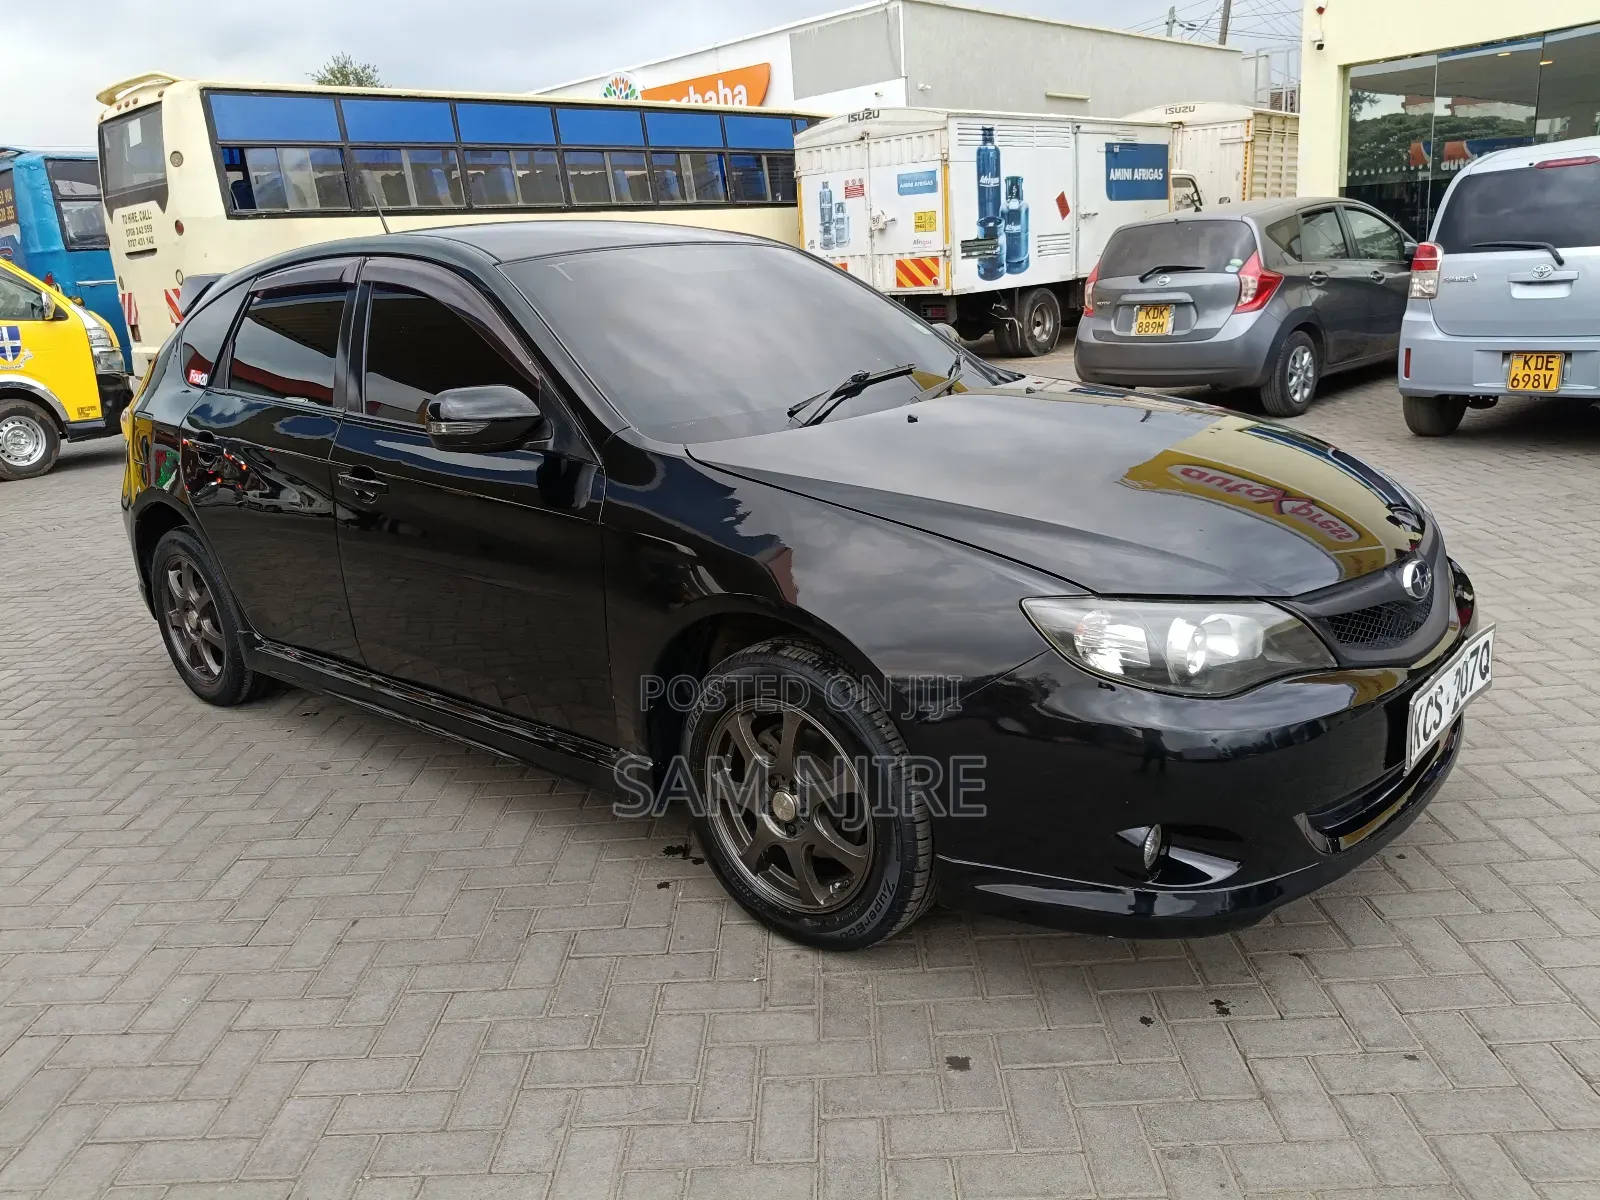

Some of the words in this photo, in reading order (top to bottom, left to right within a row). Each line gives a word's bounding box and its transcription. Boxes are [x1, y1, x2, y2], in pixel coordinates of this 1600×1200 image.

[848, 109, 880, 123] ISUZU
[1165, 105, 1196, 115] ISUZU
[1109, 168, 1132, 181] AMINI
[1133, 168, 1164, 181] AFRIGAS
[1144, 306, 1168, 320] KDK
[1137, 321, 1165, 334] 889M
[1522, 354, 1558, 371] KDE
[1510, 372, 1553, 390] 698V
[1412, 684, 1444, 752] KCS
[1451, 639, 1490, 716] 207Q
